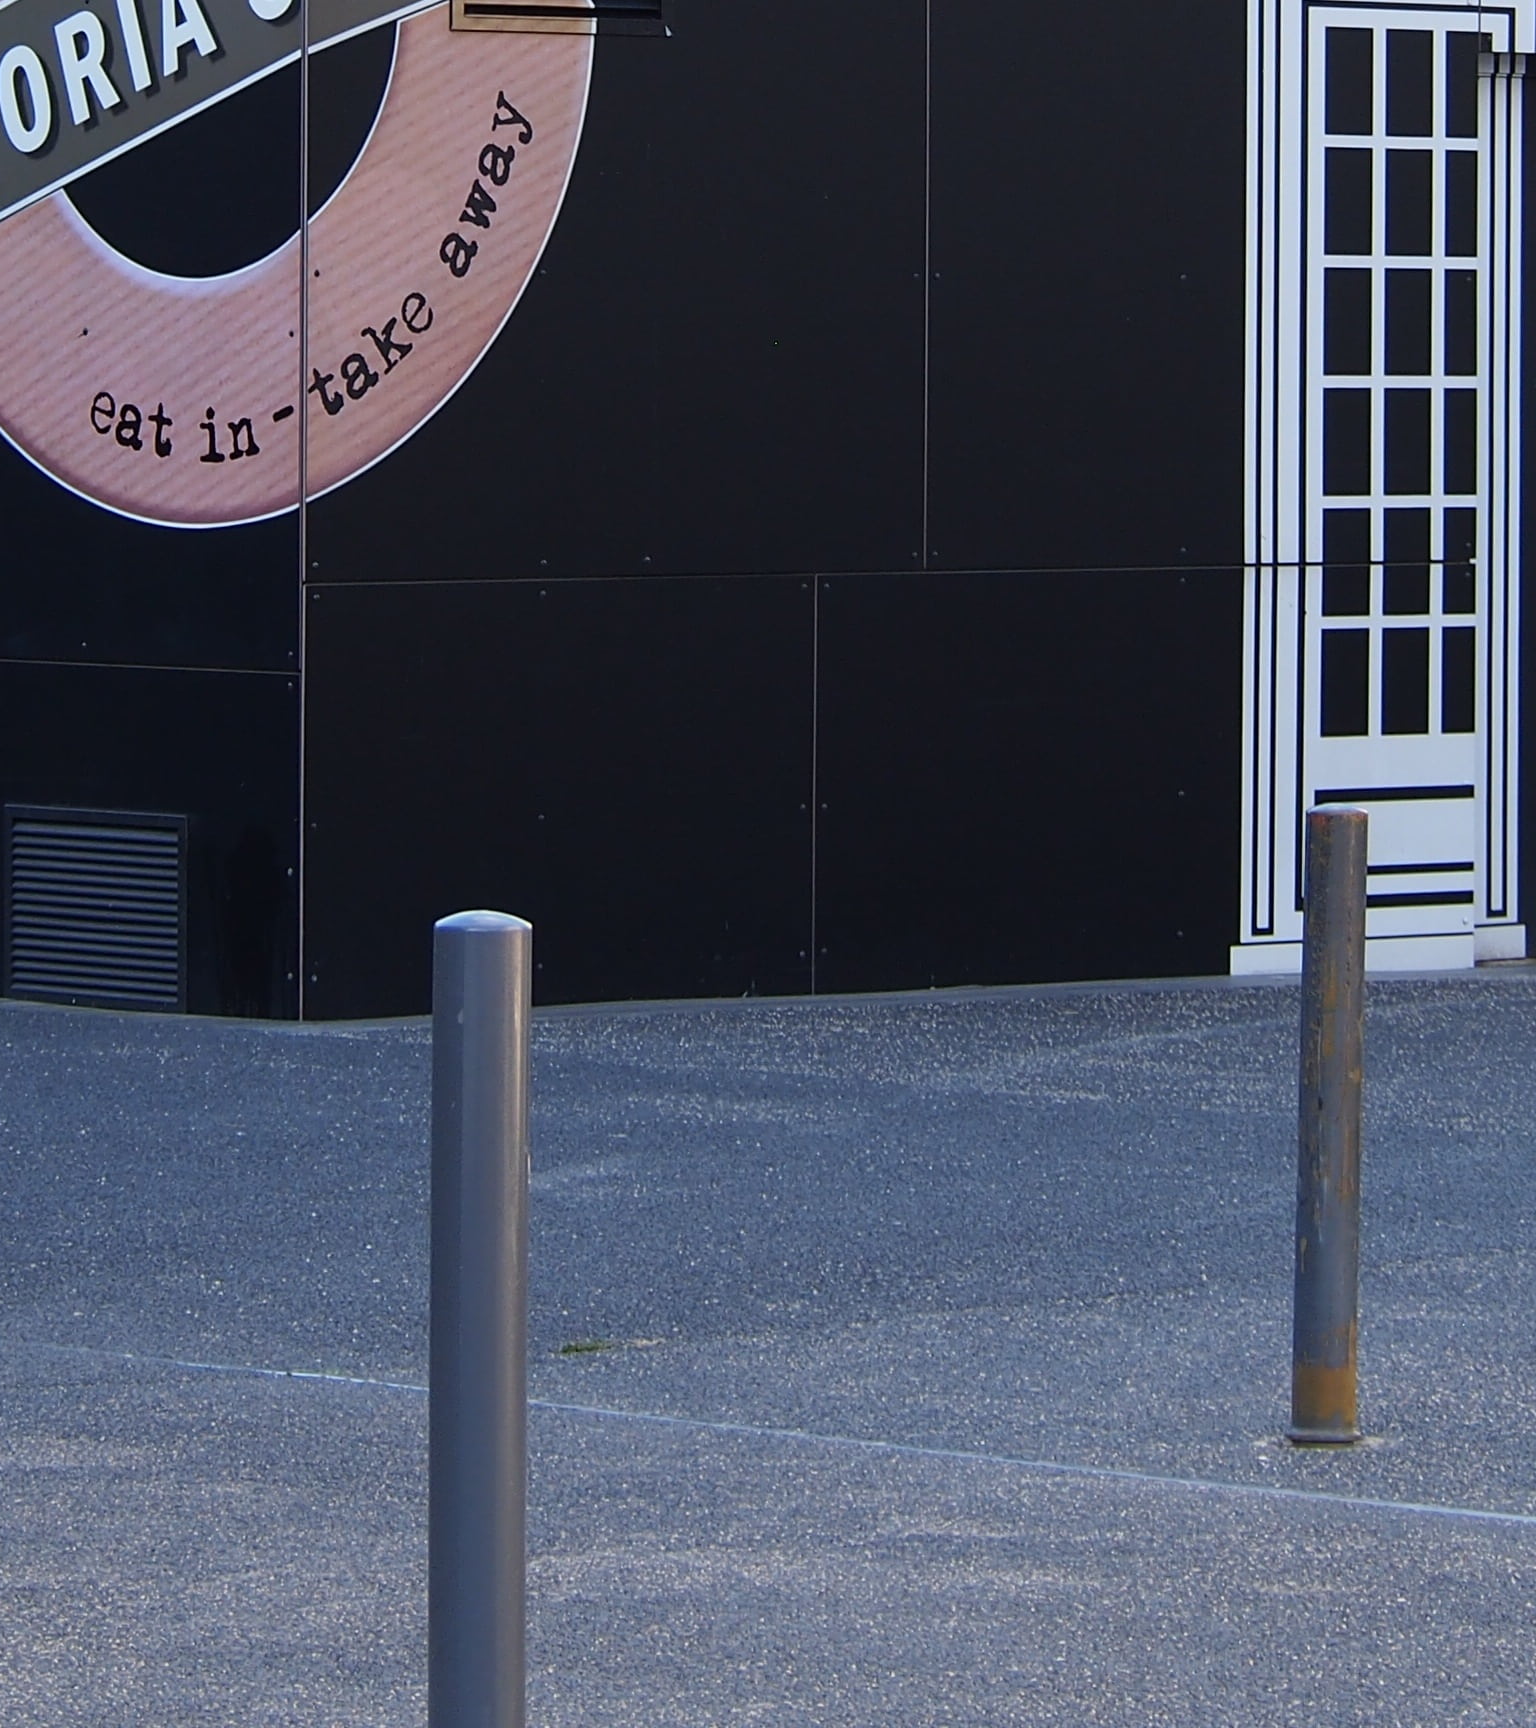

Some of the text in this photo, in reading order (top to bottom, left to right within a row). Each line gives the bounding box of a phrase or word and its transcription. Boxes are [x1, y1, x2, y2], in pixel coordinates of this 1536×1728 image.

[89, 89, 534, 464] eat in - take away
